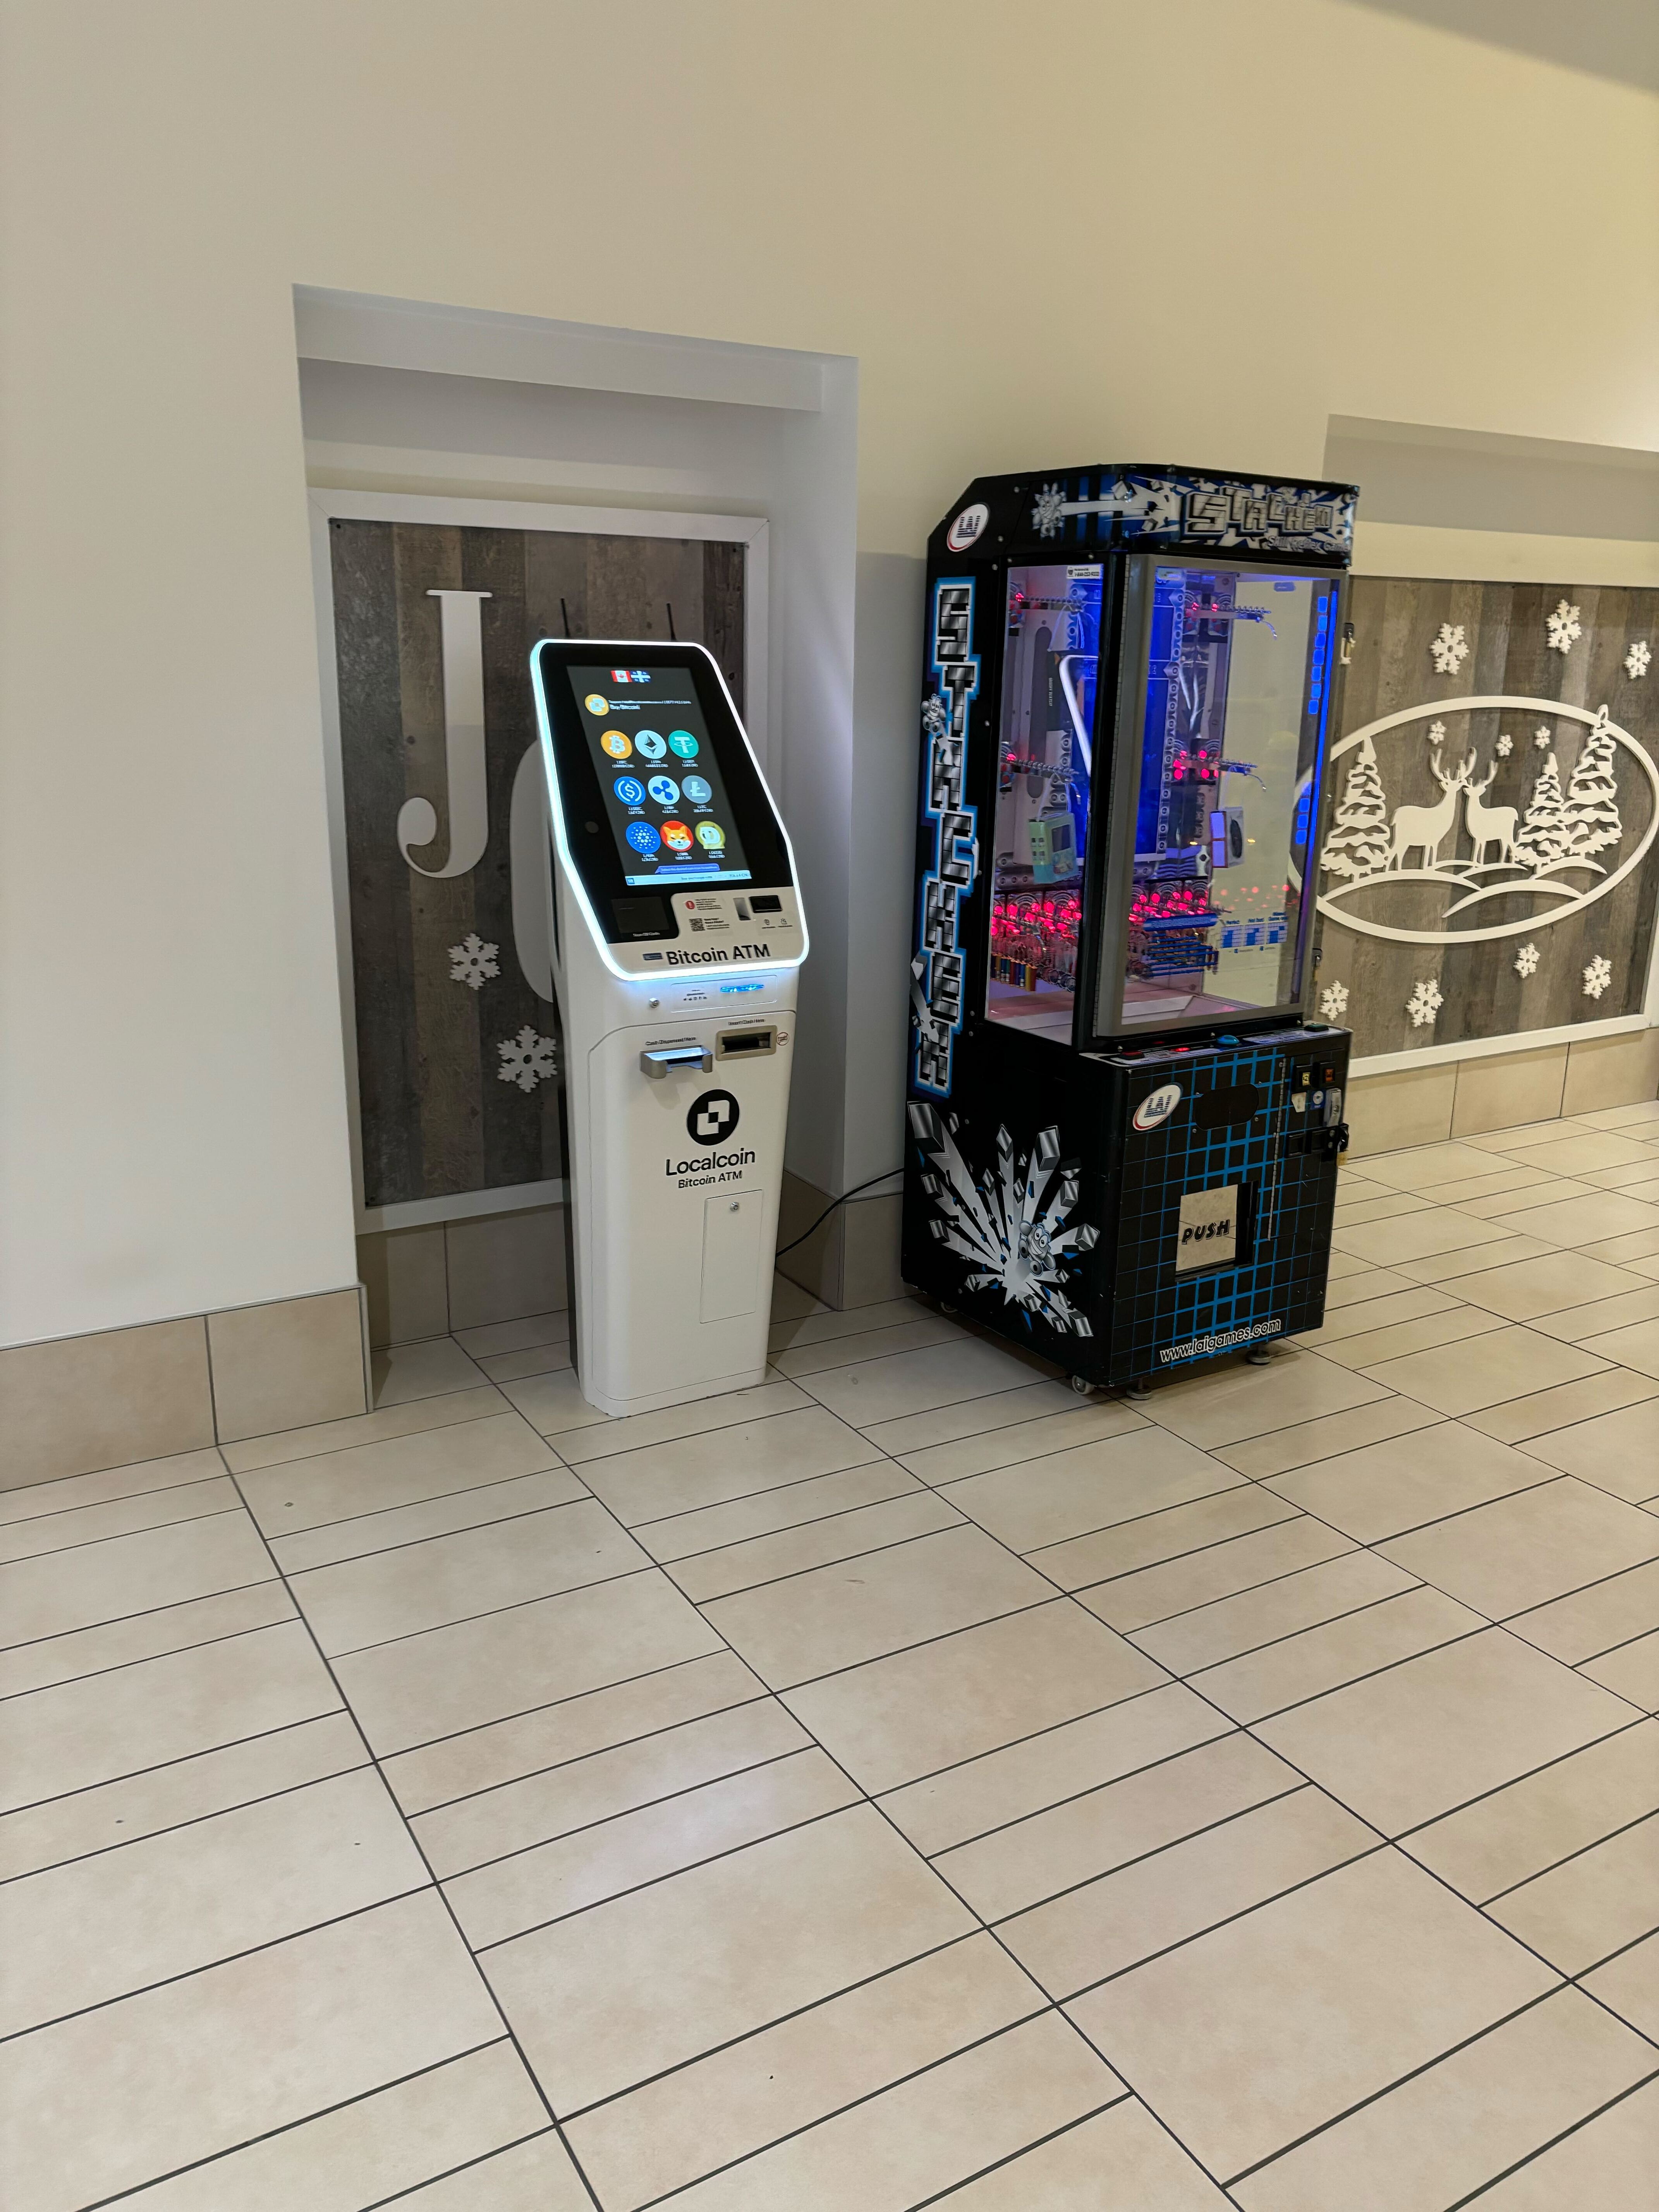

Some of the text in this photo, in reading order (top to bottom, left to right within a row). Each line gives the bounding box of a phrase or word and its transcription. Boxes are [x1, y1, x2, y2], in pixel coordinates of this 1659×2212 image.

[666, 944, 771, 965] Bitcoin ATM
[666, 1147, 755, 1176] Localcoin
[678, 1170, 742, 1188] Bitcoin ATM
[1182, 1219, 1230, 1245] PUSH
[1160, 1319, 1281, 1363] www.laigames.com
